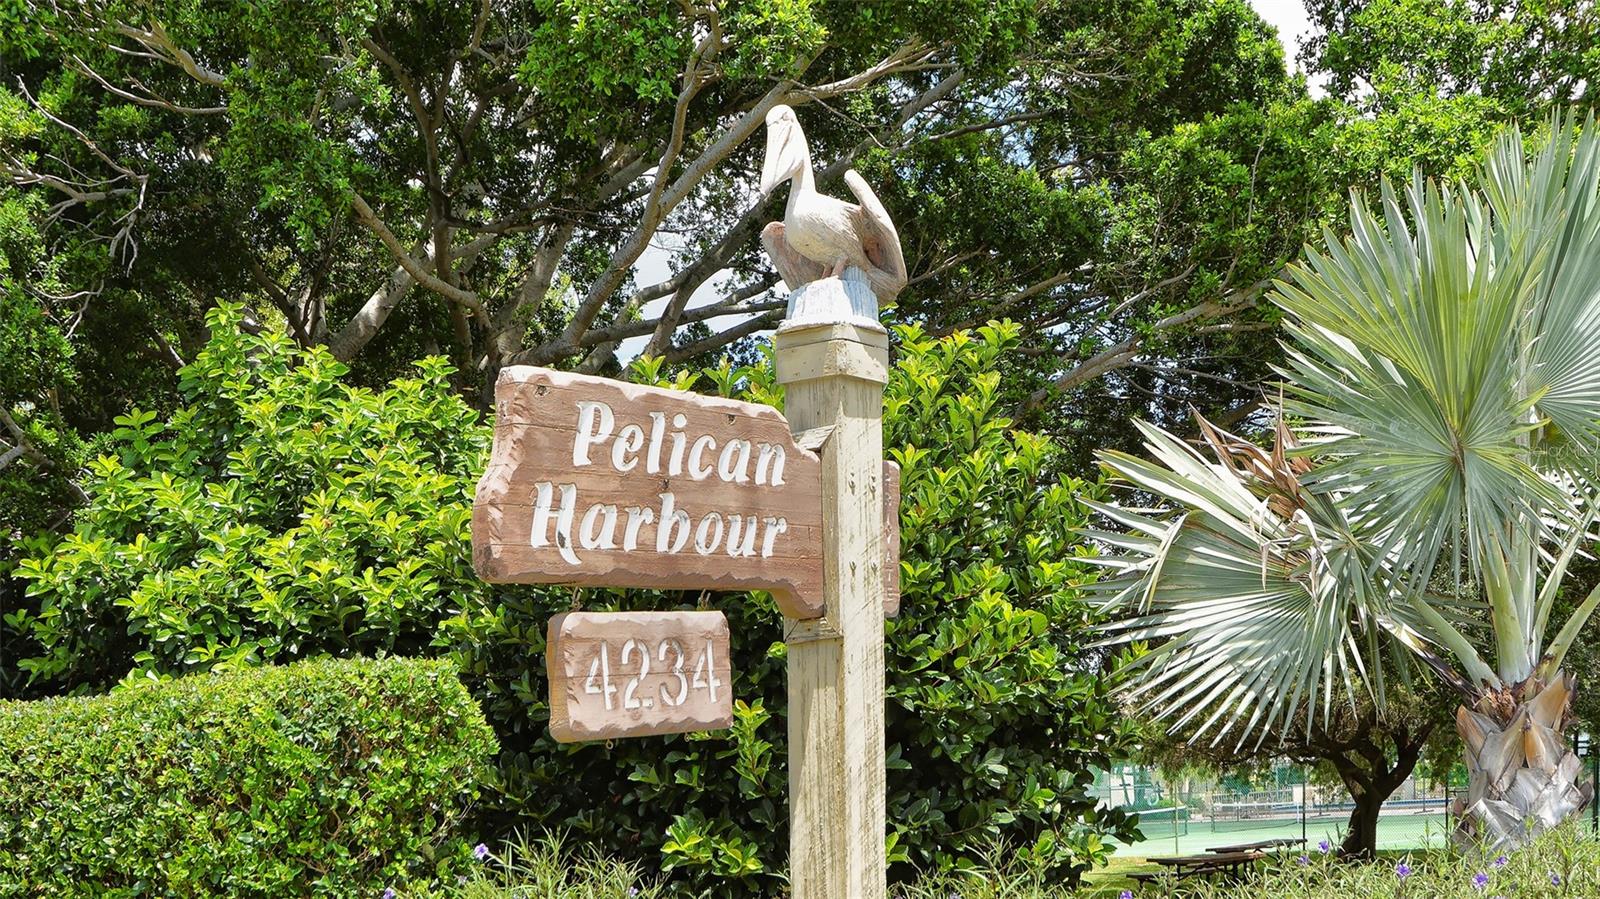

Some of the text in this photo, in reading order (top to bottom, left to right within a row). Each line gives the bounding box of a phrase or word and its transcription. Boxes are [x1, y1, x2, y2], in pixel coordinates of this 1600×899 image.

[573, 401, 787, 486] Pelican
[531, 482, 788, 565] Harbour
[585, 639, 721, 711] 4234
